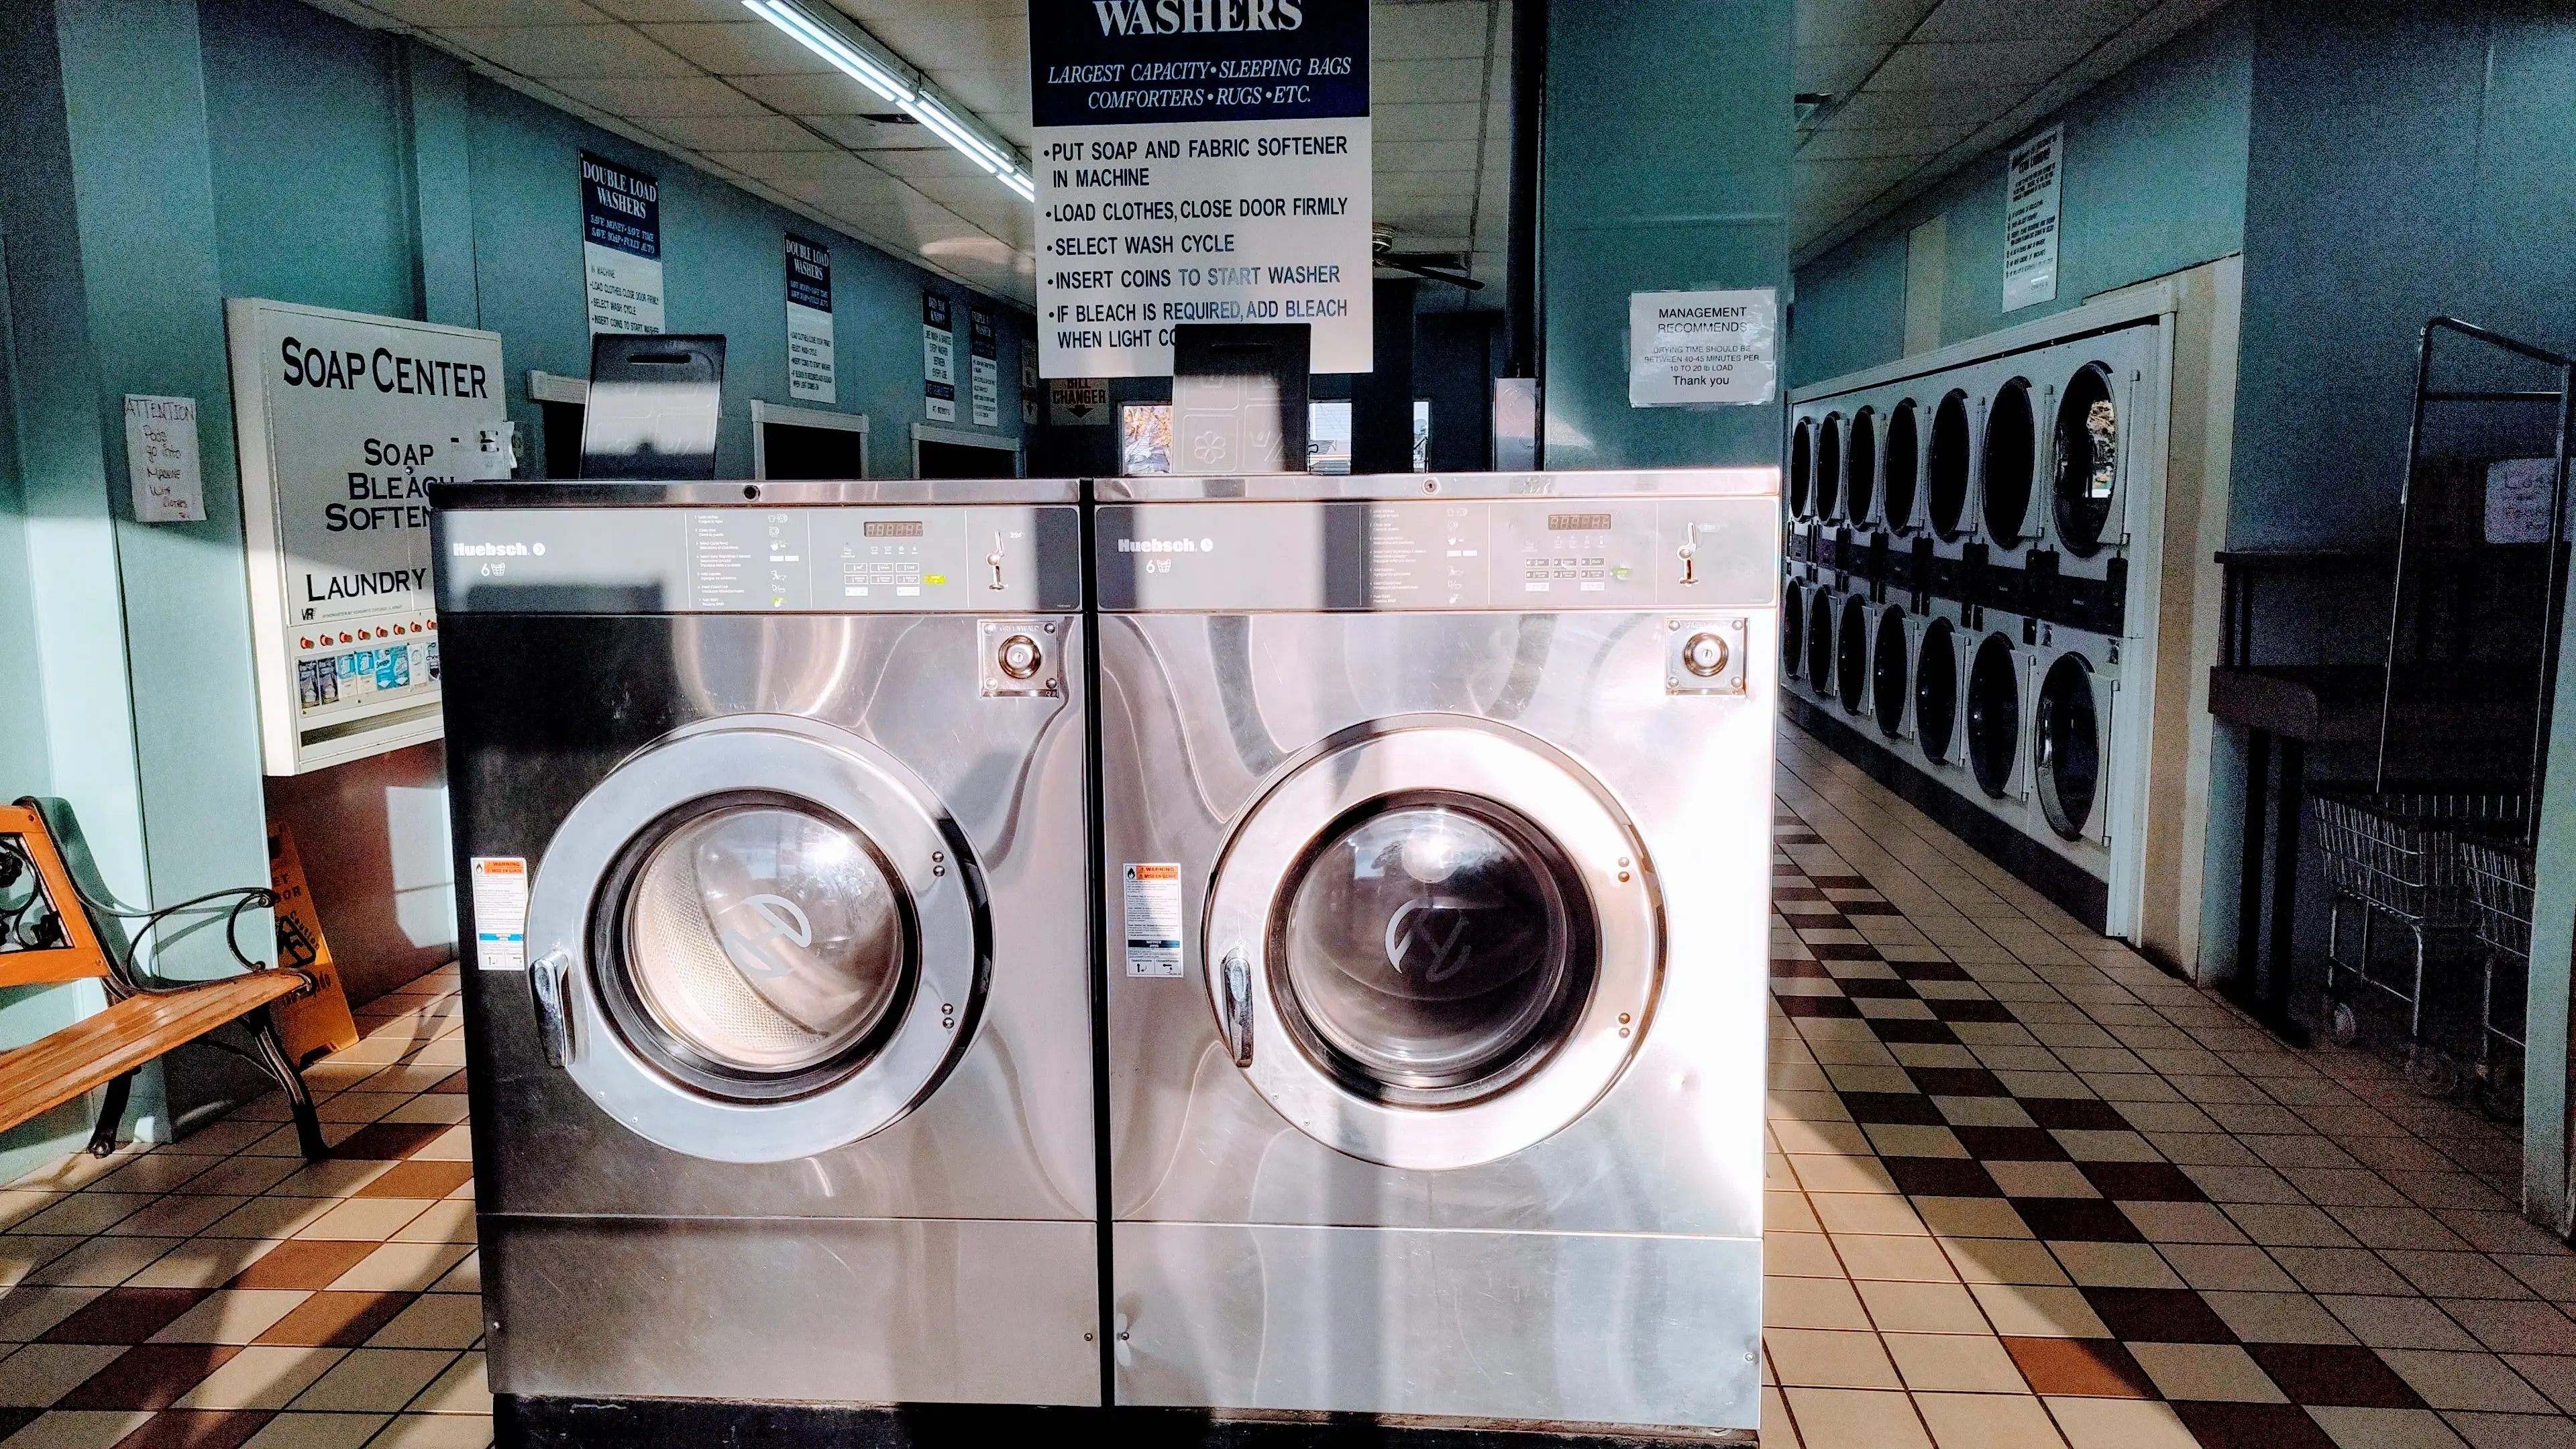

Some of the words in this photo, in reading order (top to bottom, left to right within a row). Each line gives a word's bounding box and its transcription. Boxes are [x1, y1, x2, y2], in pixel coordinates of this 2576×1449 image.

[1093, 0, 1303, 36] WASHERS
[1048, 64, 1124, 84] LARGEST
[1132, 62, 1210, 82] CAPACITY
[1220, 58, 1302, 78] SLEEPING
[1309, 57, 1352, 76] BAGS
[1088, 89, 1203, 109] COMFORTERS
[1216, 87, 1262, 105] RUGS
[1273, 85, 1311, 104] ETC.
[1053, 143, 1084, 161] PUT
[1091, 142, 1137, 160] SOAP
[1145, 140, 1180, 158] AND
[1189, 138, 1249, 158] FABRIC
[1257, 136, 1347, 156] SOFTENER
[583, 160, 627, 193] DOUBLE
[630, 178, 656, 202] LOAD
[1053, 170, 1067, 188] IN
[1077, 168, 1149, 187] MACHINE
[597, 186, 646, 219] WASHERS
[1055, 203, 1095, 222] LOAD
[1181, 200, 1232, 219] CLOSE
[1240, 199, 1285, 217] DOOR
[1293, 197, 1348, 216] FIRMLY
[786, 239, 811, 261] DOUBLE
[813, 249, 828, 267] LOAD
[1056, 237, 1118, 256] SELECT
[1125, 235, 1173, 254] WASH
[1181, 234, 1234, 253] CYCLE
[794, 258, 823, 280] WASHERS
[1057, 270, 1114, 289] INSERT
[1121, 269, 1171, 288] COINS
[1179, 268, 1200, 286] TO
[1208, 266, 1260, 285] START
[1269, 265, 1340, 284] WASHER
[593, 298, 609, 309] SELECT
[1057, 305, 1069, 323] IF
[1076, 303, 1136, 322] BLEACH
[1144, 303, 1156, 321] IS
[1247, 300, 1278, 319] ADD
[1286, 299, 1347, 317] BLEACH
[1659, 307, 1747, 318] MANAGEMENT
[1658, 322, 1748, 333] RECOMMENDS
[1058, 330, 1102, 349] WHEN
[1110, 329, 1150, 347] LIGHT
[282, 337, 366, 390] SOAP
[372, 347, 488, 399] CENTER
[1067, 378, 1091, 389] BILL
[1673, 376, 1707, 386] Thank
[1710, 378, 1729, 387] you
[1053, 390, 1106, 404] CHANGER
[125, 398, 195, 421] ATTENTION
[364, 438, 434, 466] SOAP
[347, 472, 455, 500] BLEAC
[453, 542, 529, 556] Huebsch
[1118, 538, 1196, 552] Huebsch
[481, 564, 490, 576] 6
[1146, 559, 1155, 574] 6
[305, 568, 427, 602] LAUNDRY
[272, 873, 290, 888] ET
